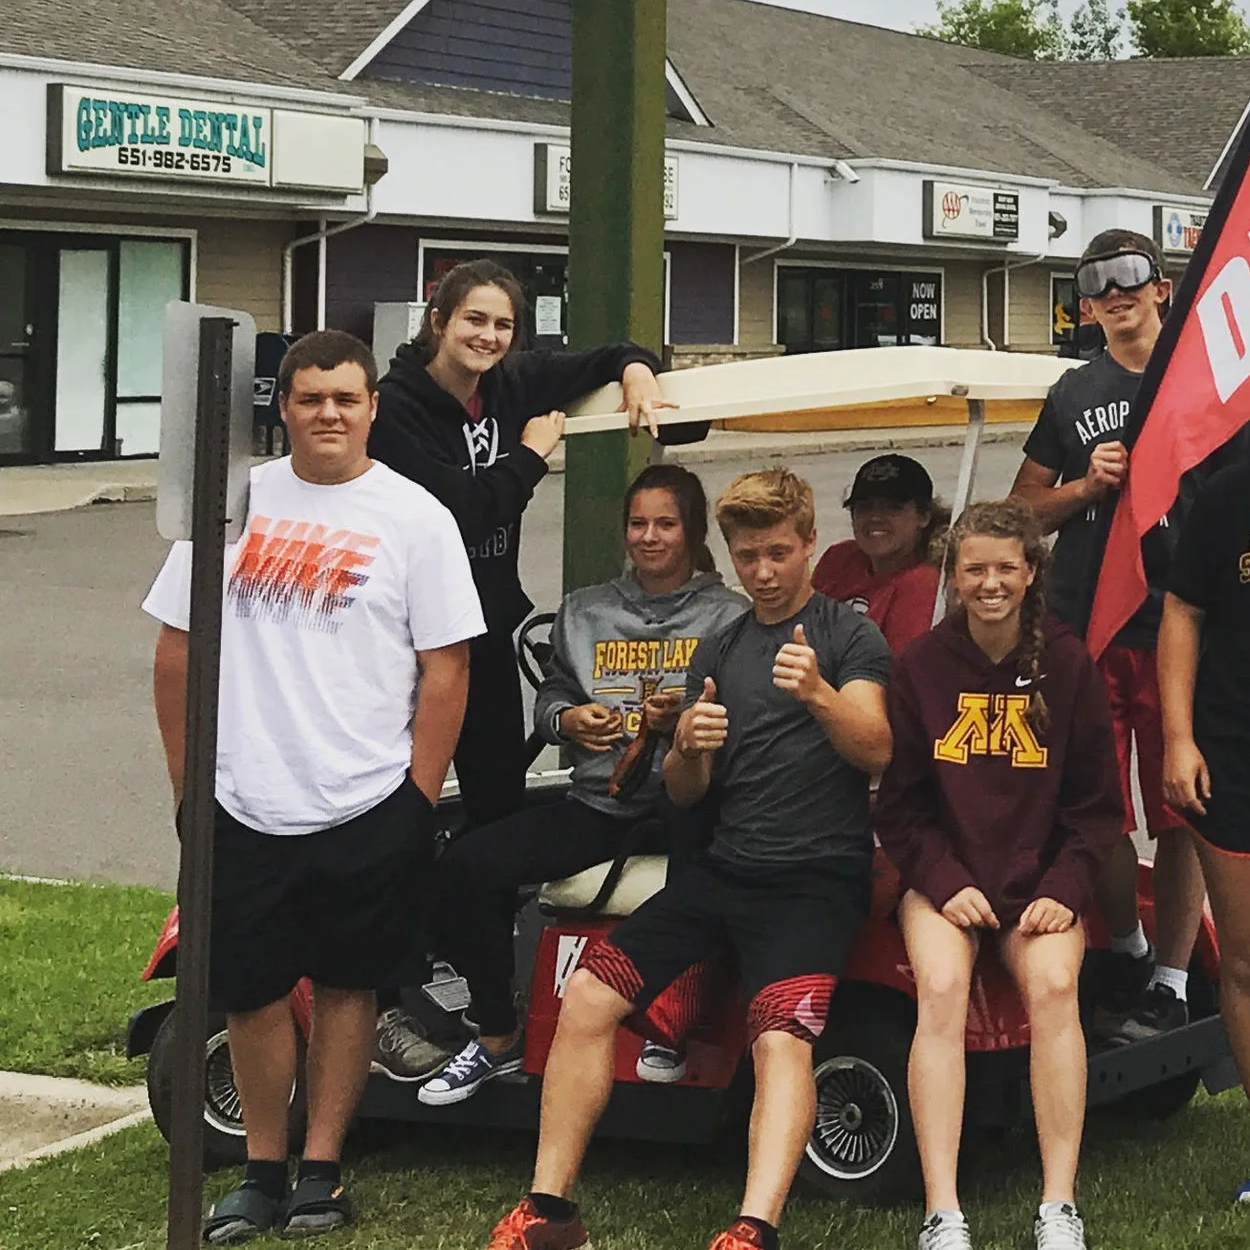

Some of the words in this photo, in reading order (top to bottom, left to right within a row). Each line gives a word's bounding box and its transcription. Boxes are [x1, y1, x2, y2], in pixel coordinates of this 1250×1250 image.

[77, 97, 170, 151] GENTLE
[178, 108, 265, 168] DENTAL
[910, 303, 937, 319] OPEN
[912, 282, 935, 299] NOW
[1075, 401, 1130, 445] AEROP
[593, 639, 660, 679] FOREST
[662, 637, 699, 668] LAK
